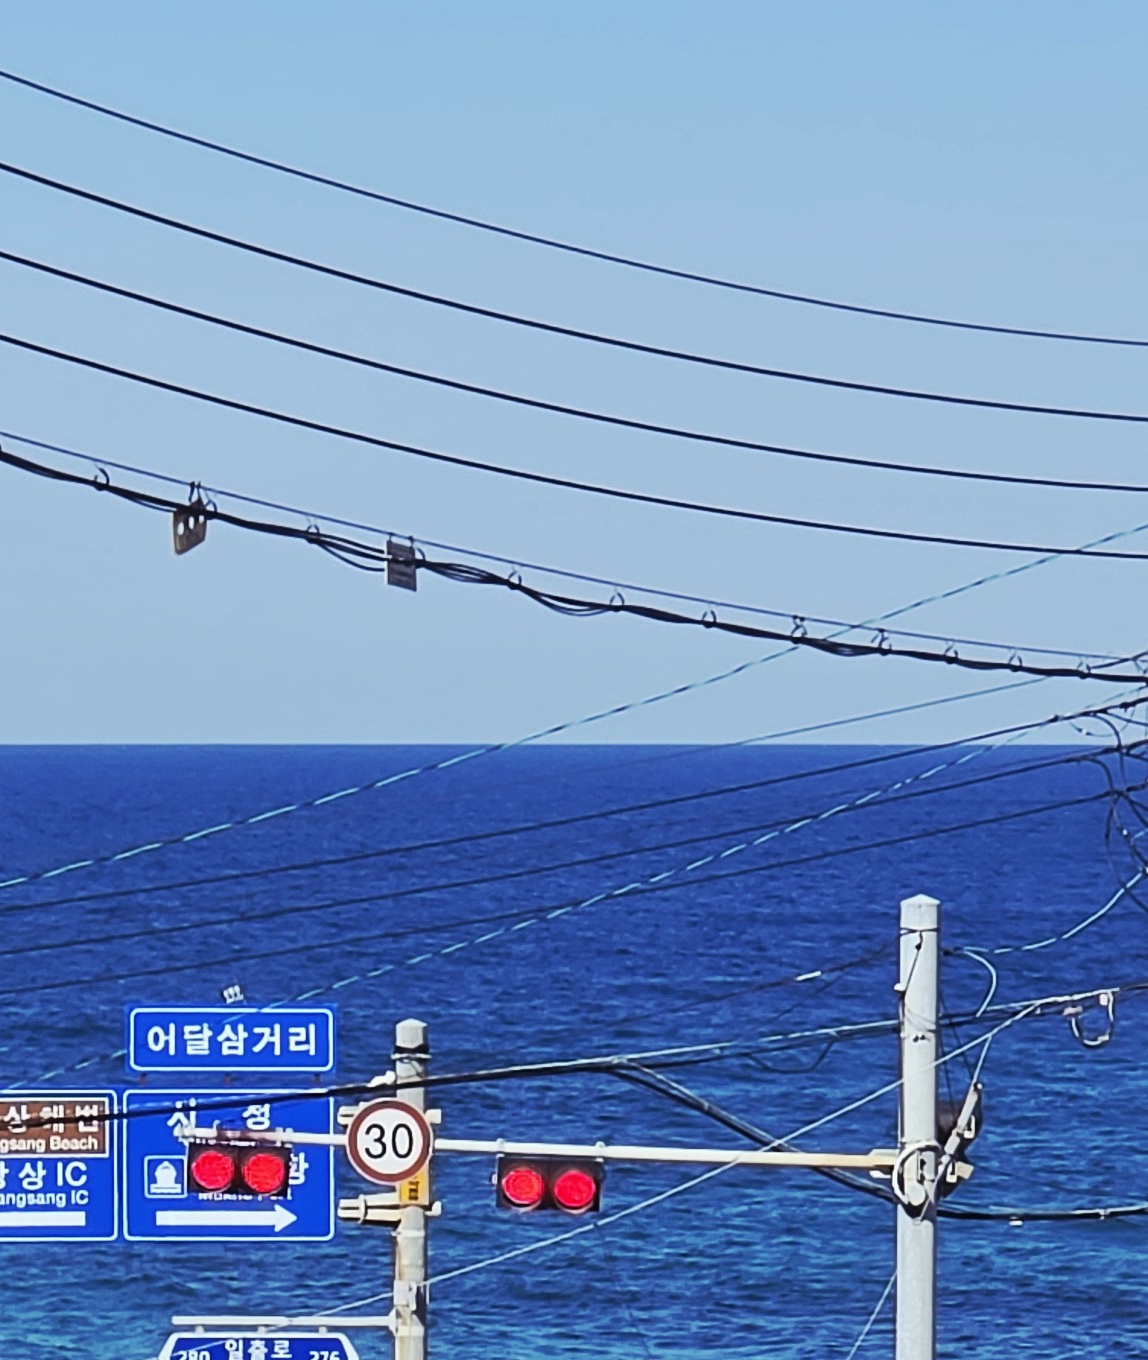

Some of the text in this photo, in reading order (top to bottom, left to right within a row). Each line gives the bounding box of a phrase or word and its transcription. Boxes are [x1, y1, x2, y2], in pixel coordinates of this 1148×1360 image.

[147, 1022, 316, 1056] 어달삼거리
[49, 1135, 99, 1151] Beach
[364, 1123, 414, 1159] 30
[57, 1161, 88, 1187] IC
[71, 1190, 89, 1205] IC
